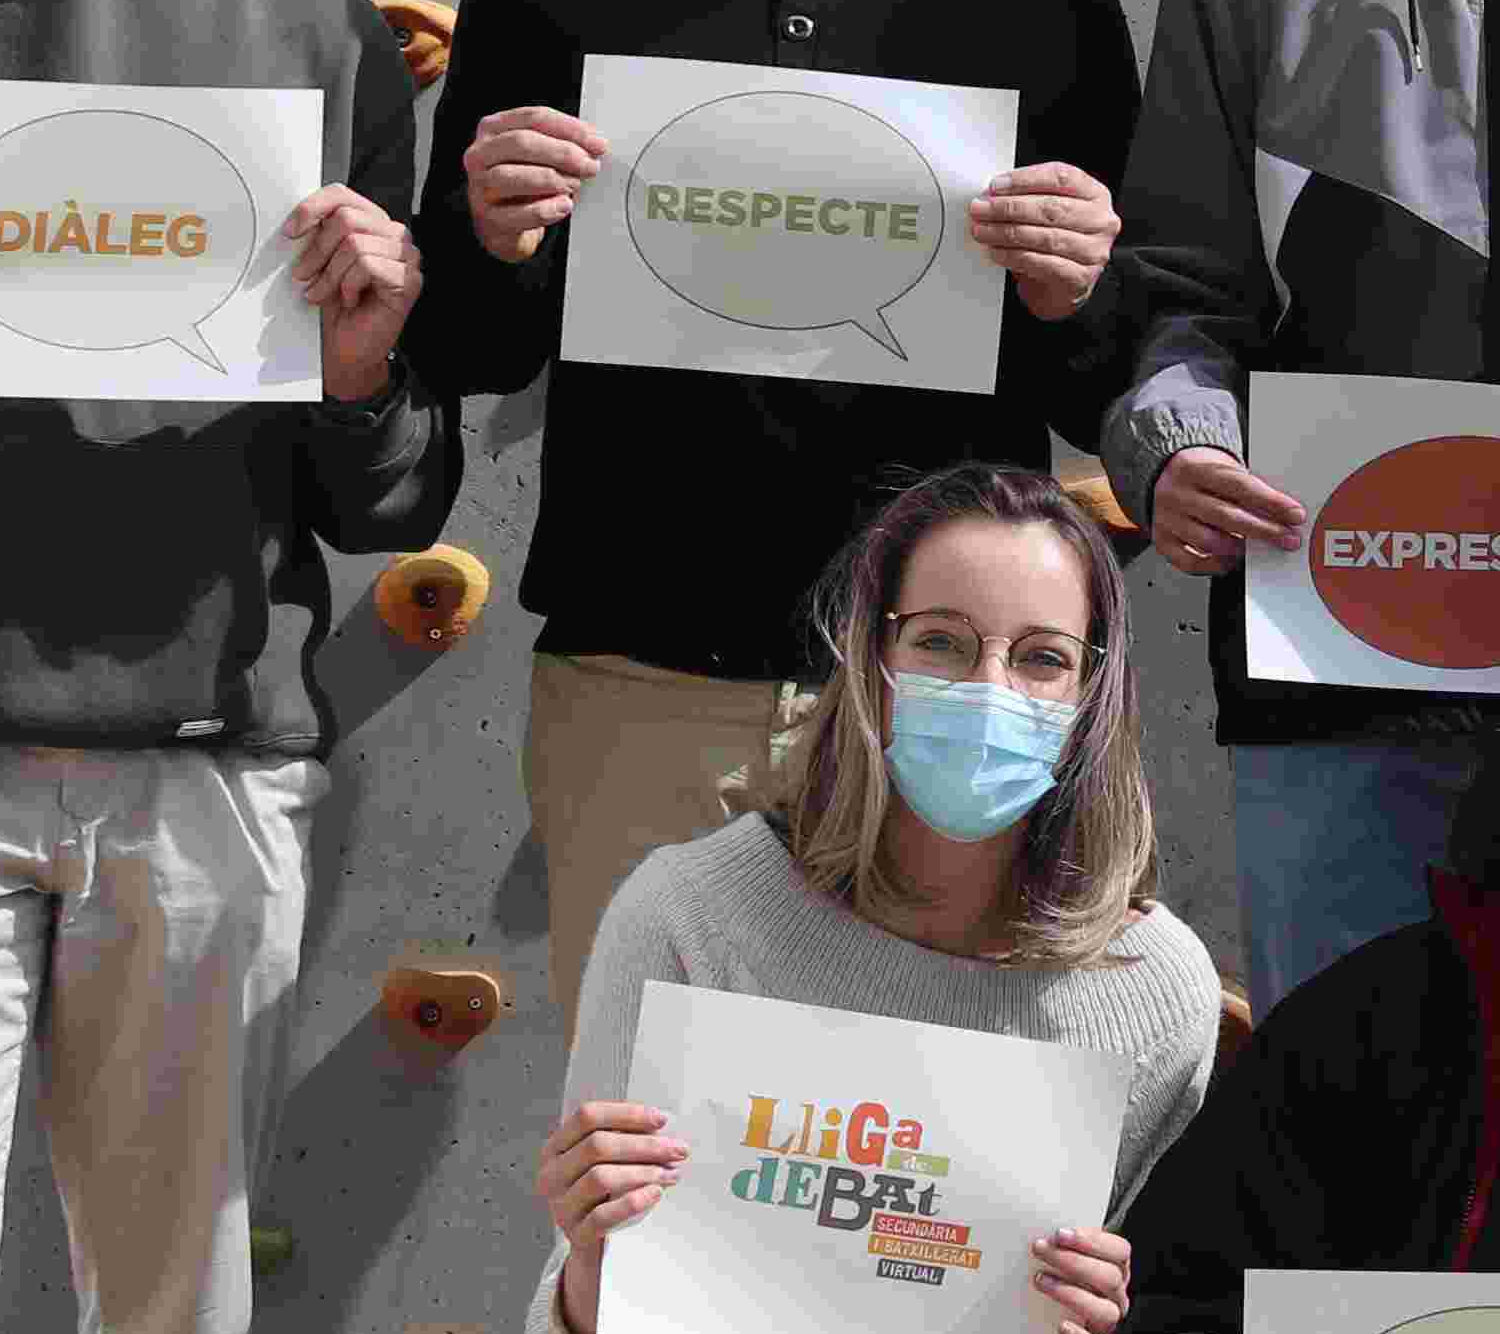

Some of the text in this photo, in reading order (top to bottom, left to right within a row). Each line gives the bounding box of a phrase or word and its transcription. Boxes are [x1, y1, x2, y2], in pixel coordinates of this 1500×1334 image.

[646, 184, 921, 241] RESPECTE
[885, 1238, 976, 1266] BATXILLERAT
[881, 1260, 941, 1281] VIRTUAL
